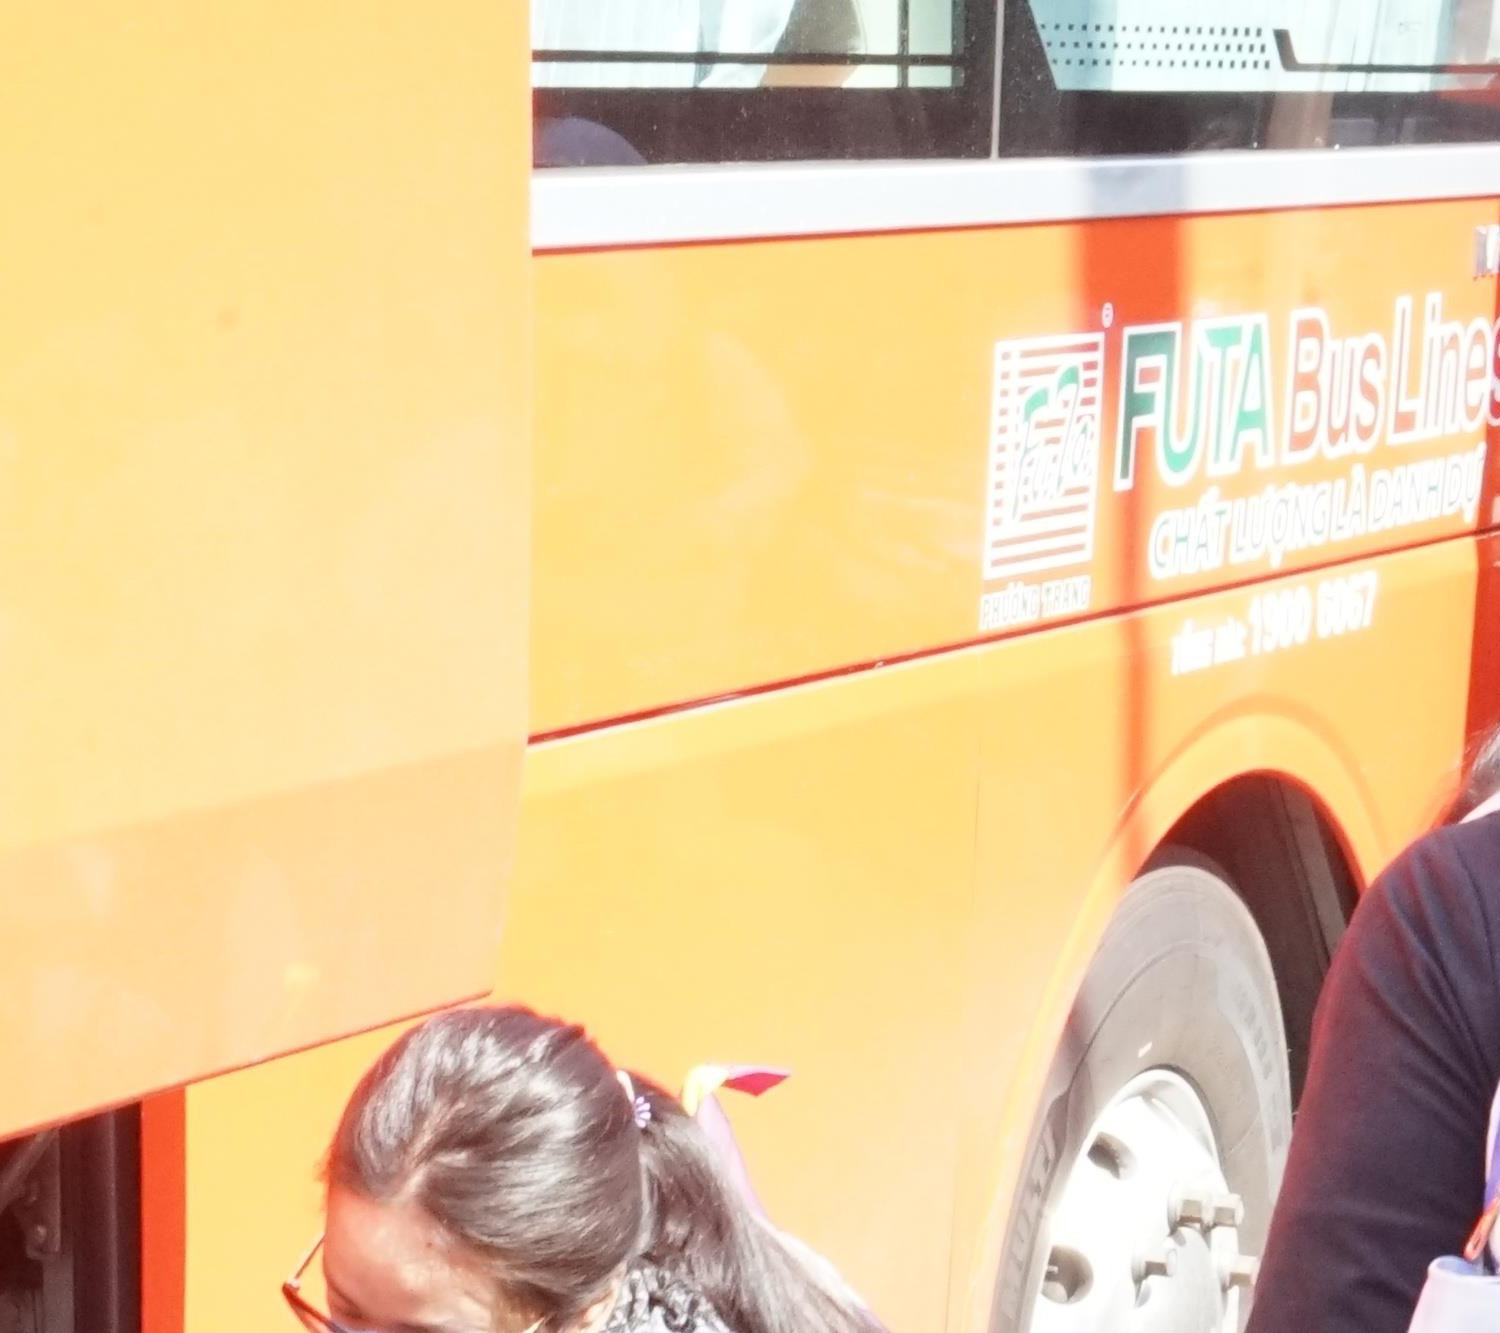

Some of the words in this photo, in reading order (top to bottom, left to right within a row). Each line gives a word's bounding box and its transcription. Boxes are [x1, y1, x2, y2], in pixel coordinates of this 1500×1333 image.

[1116, 317, 1270, 489] FUTA
[1286, 309, 1384, 461] Bus
[1151, 488, 1231, 577] CHẤT
[1232, 484, 1327, 567] LƯỢNG
[1331, 466, 1366, 538] LÀ
[1372, 456, 1446, 530] DANH
